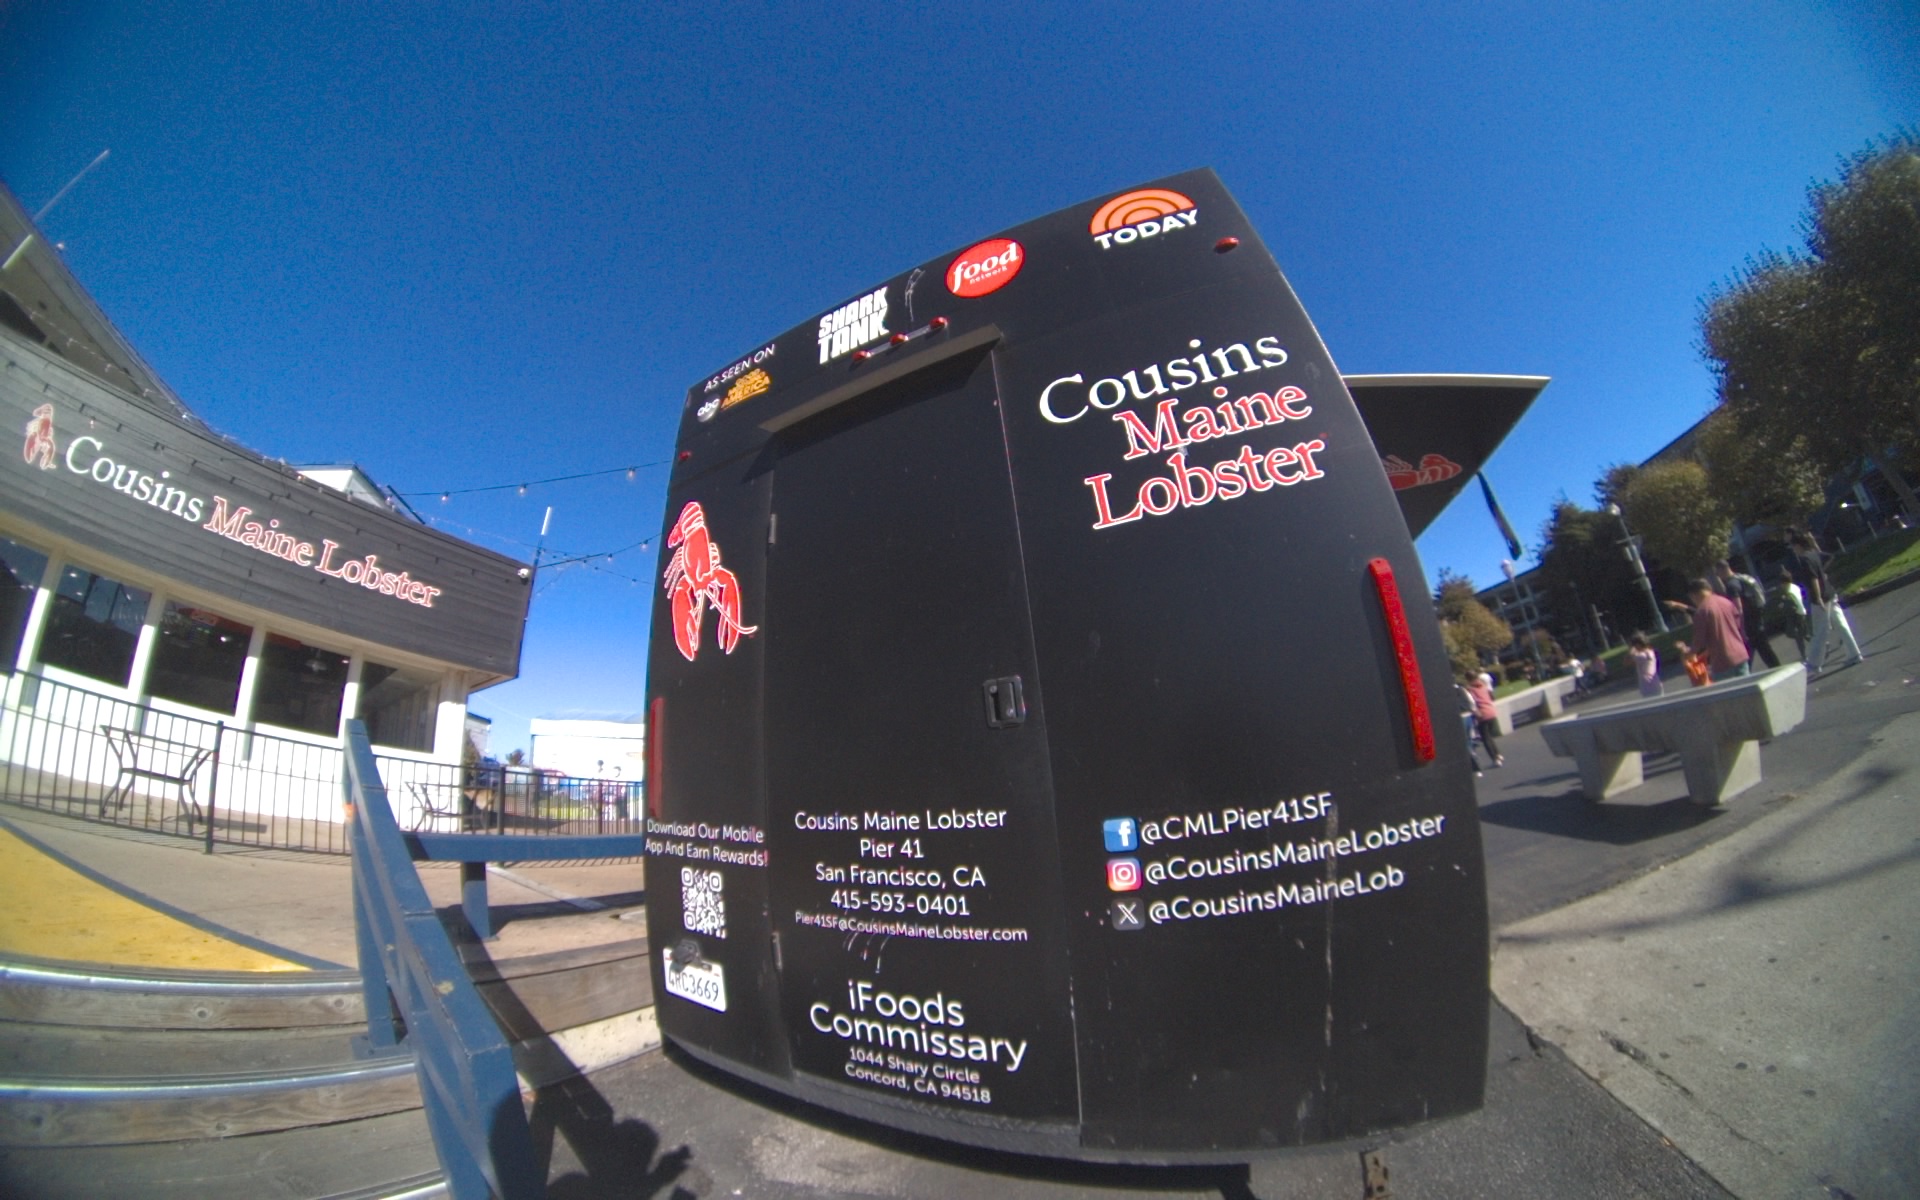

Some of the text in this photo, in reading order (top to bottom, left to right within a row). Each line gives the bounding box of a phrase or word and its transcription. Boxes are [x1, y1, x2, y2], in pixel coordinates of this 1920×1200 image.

[1094, 209, 1198, 250] TODAY
[952, 242, 1019, 293] food
[969, 265, 1007, 285] network
[818, 286, 888, 338] SHARK
[818, 307, 890, 365] TANK
[704, 376, 720, 393] AS
[721, 356, 752, 383] SEEN
[754, 344, 776, 363] ON
[1039, 336, 1288, 423] Cousins
[1112, 385, 1312, 461] Maine
[1084, 439, 1326, 530] Lobster
[65, 436, 440, 608] Cousins Maine Lobster
[646, 818, 764, 843] Download Our Mobile
[794, 808, 1007, 831] Cousins Maine Lobster
[1141, 792, 1334, 845] @CMLPier41SF
[645, 838, 769, 867] App And Earn Rewards!
[860, 838, 925, 859] Pier 41
[1145, 814, 1445, 885] @CousinsMaineLobster
[815, 862, 986, 889] San Francisco, CA
[1150, 864, 1404, 924] @CousinsMaineLob
[795, 911, 1028, 942] Pier41SF@CousinsMaineLobster.com
[830, 890, 970, 916] 415-593-0401
[848, 979, 965, 1027] iFoods
[810, 1002, 1028, 1072] Commissary
[845, 1063, 992, 1104] Concord, CA 94518
[850, 1048, 980, 1084] 1044 Shary Circle
